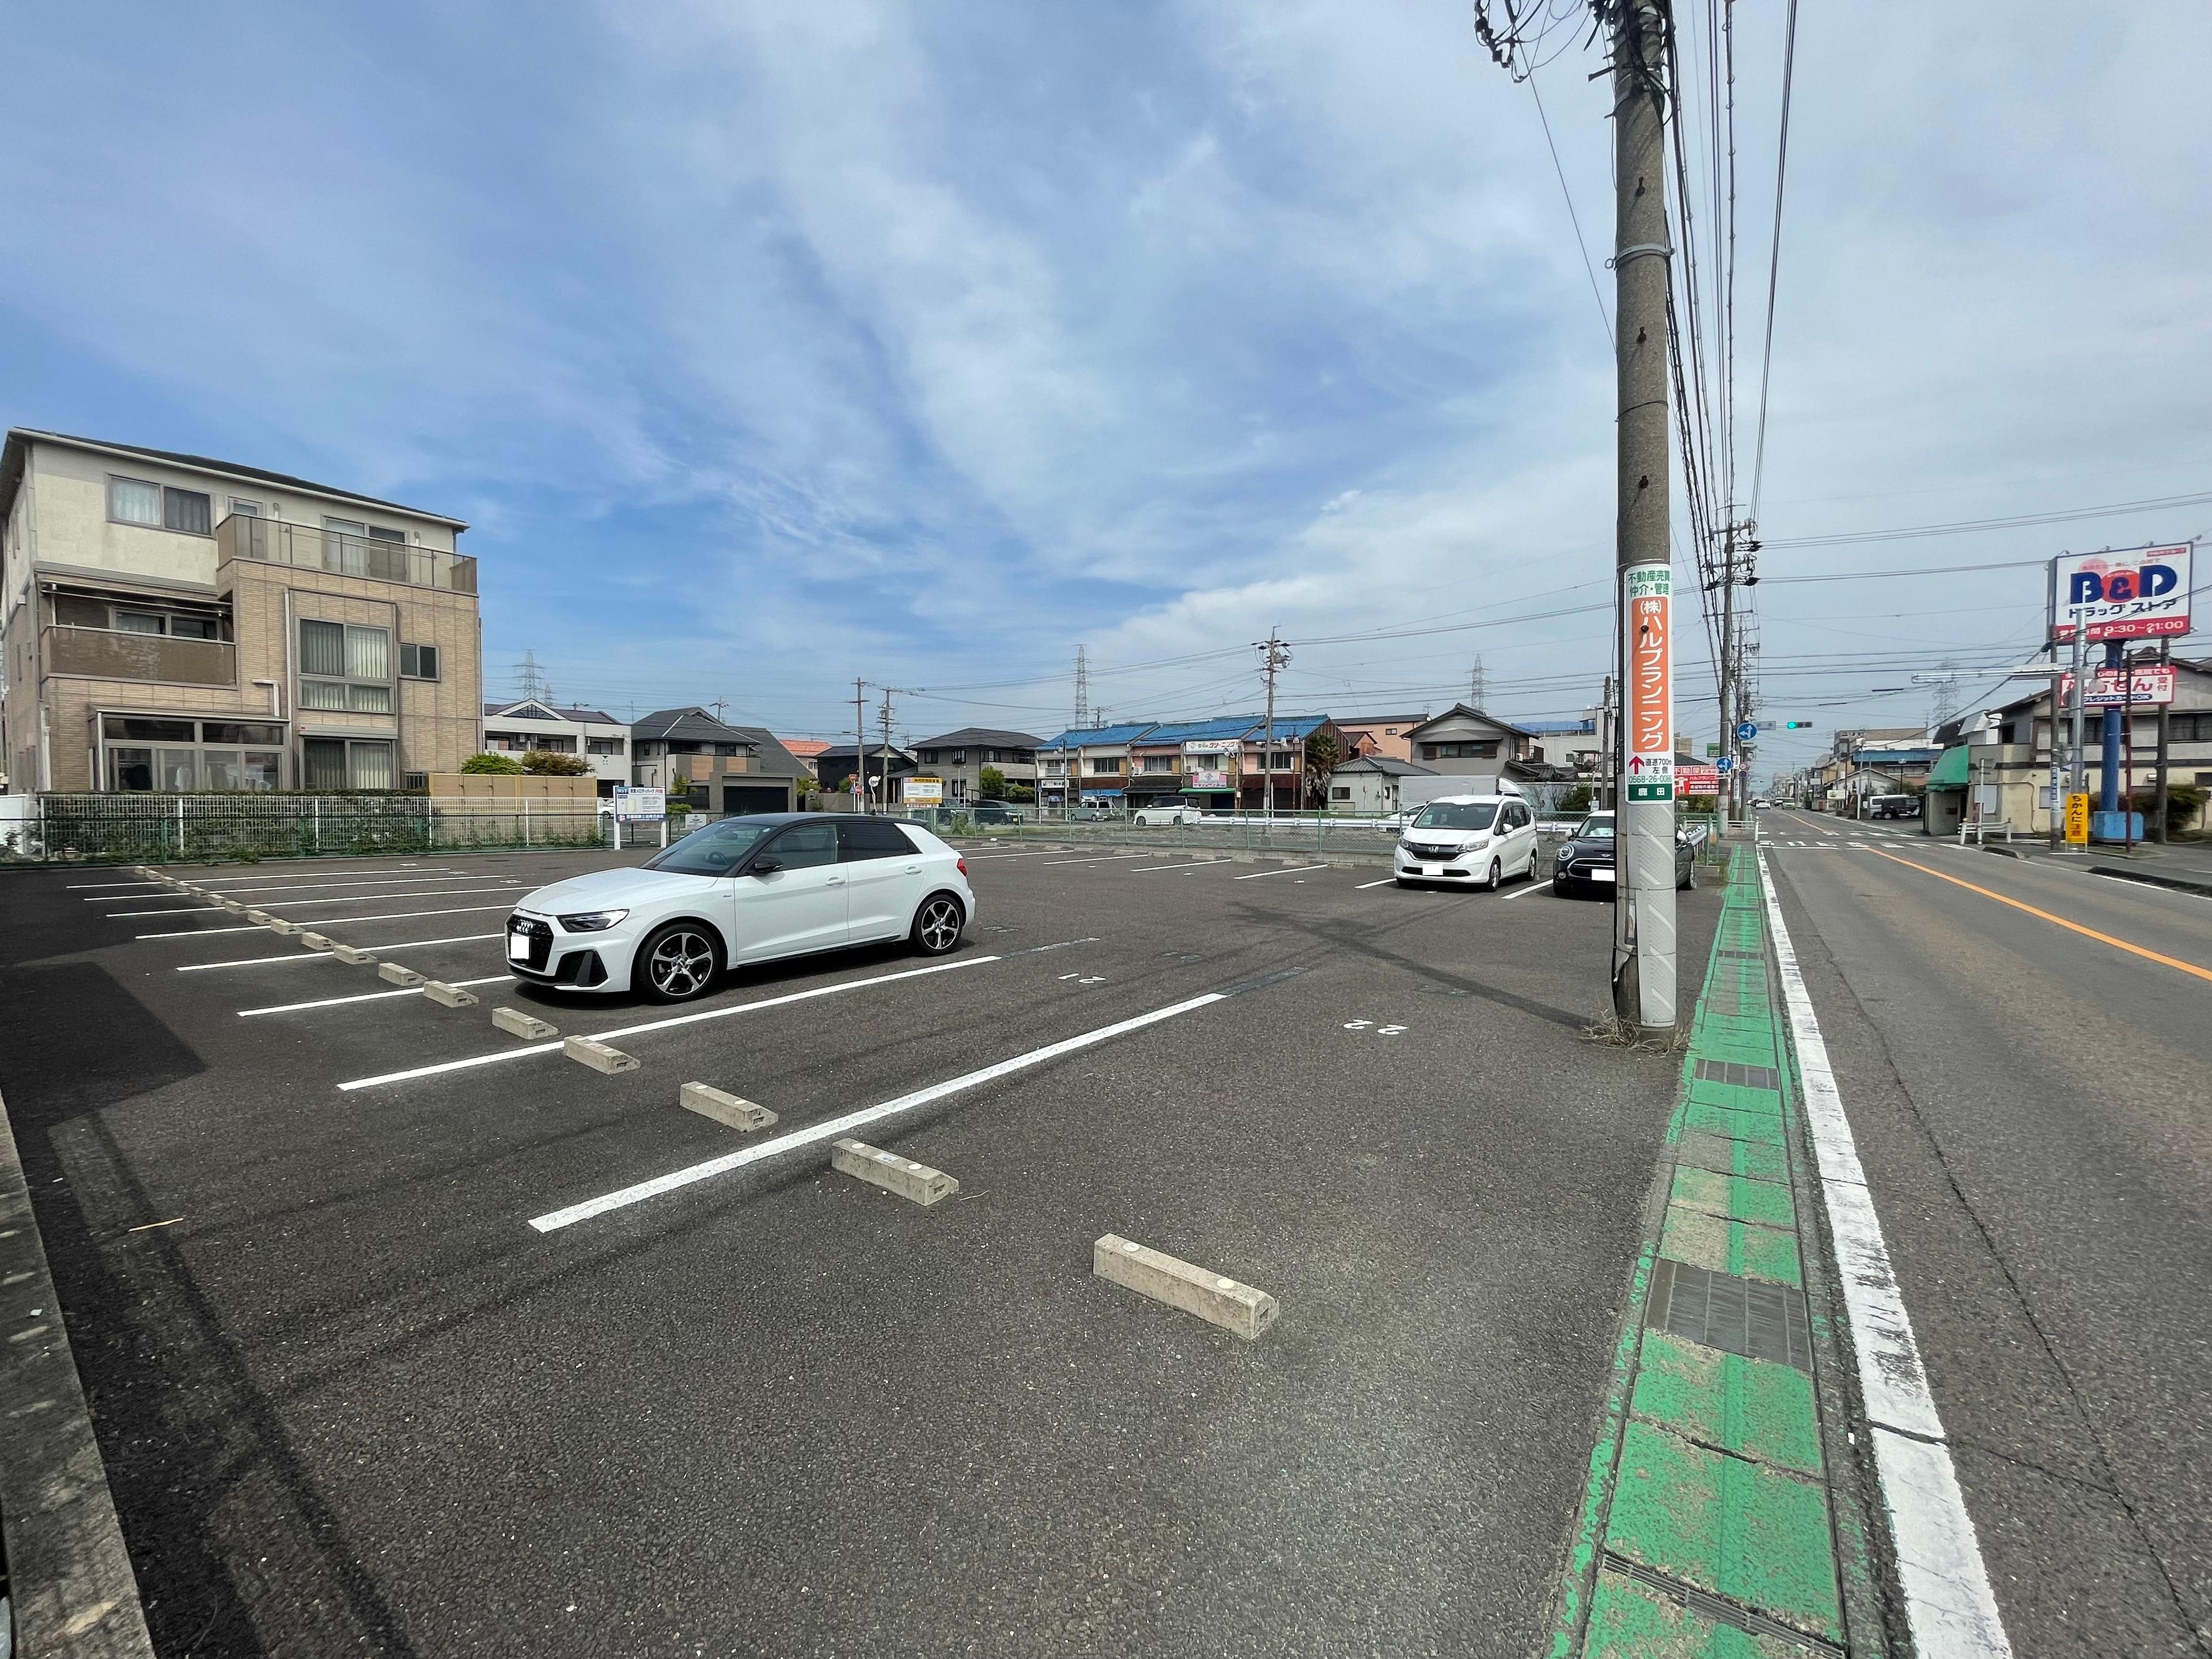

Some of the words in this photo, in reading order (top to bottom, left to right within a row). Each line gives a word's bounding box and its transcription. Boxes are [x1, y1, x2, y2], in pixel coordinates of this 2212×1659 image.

[1630, 583, 1669, 597] 仲介・管理
[2070, 565, 2177, 604] B&D
[2070, 795, 2082, 836] ちかんに注意
